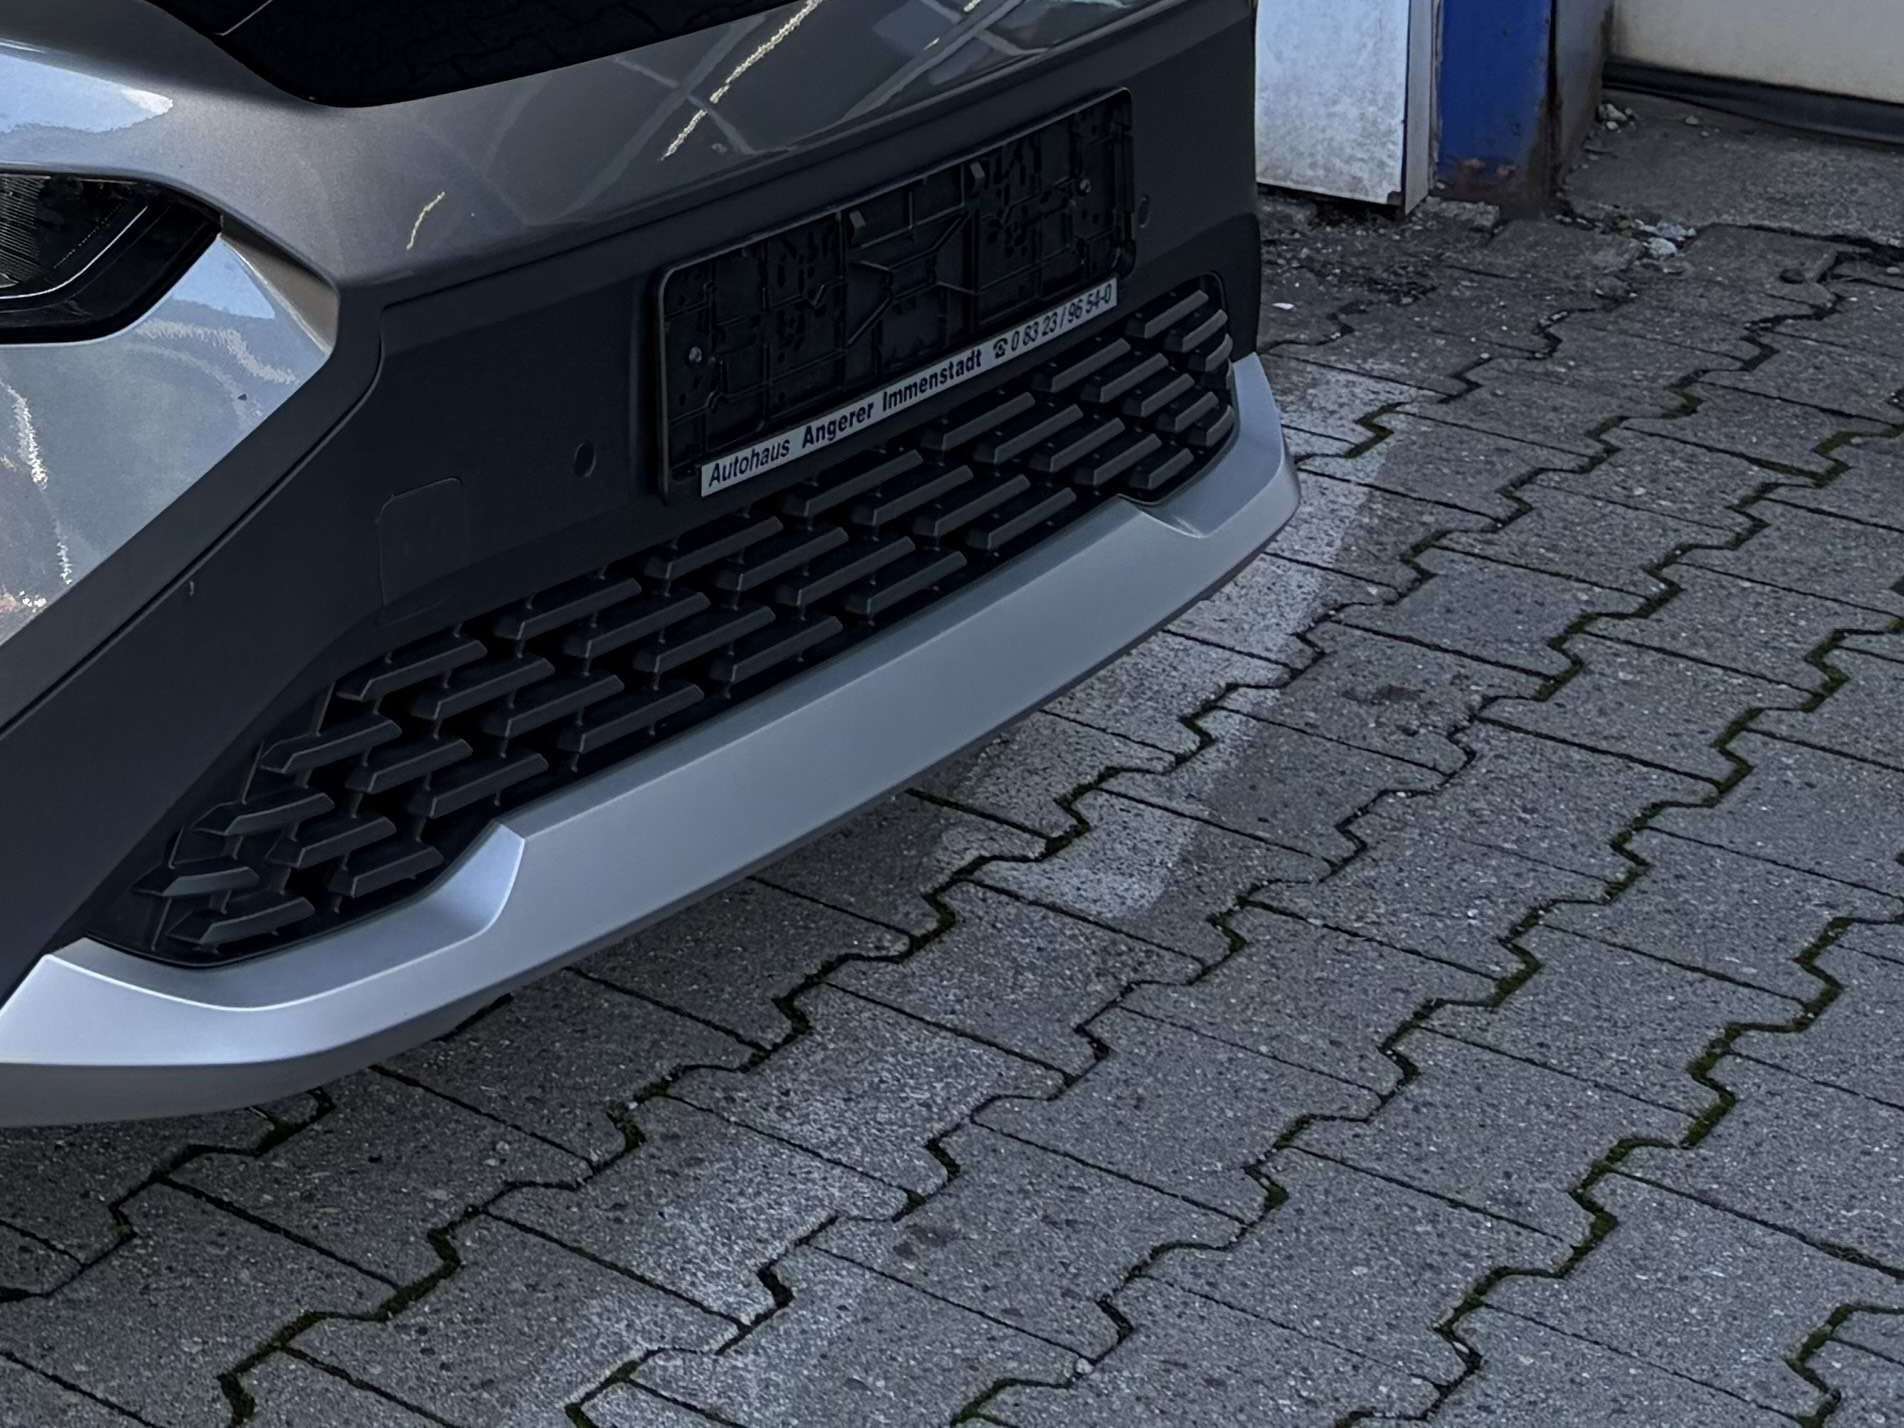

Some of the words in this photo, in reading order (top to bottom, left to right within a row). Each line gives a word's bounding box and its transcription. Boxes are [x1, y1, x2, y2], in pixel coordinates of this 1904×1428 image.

[709, 437, 791, 487] Autohaus
[802, 402, 874, 449] Angerer
[882, 348, 982, 412] Immenstadt
[1012, 331, 1020, 351] 0
[1023, 322, 1038, 346] 83
[1042, 312, 1058, 336] 23
[1060, 307, 1066, 328] /
[1068, 300, 1082, 323] 96
